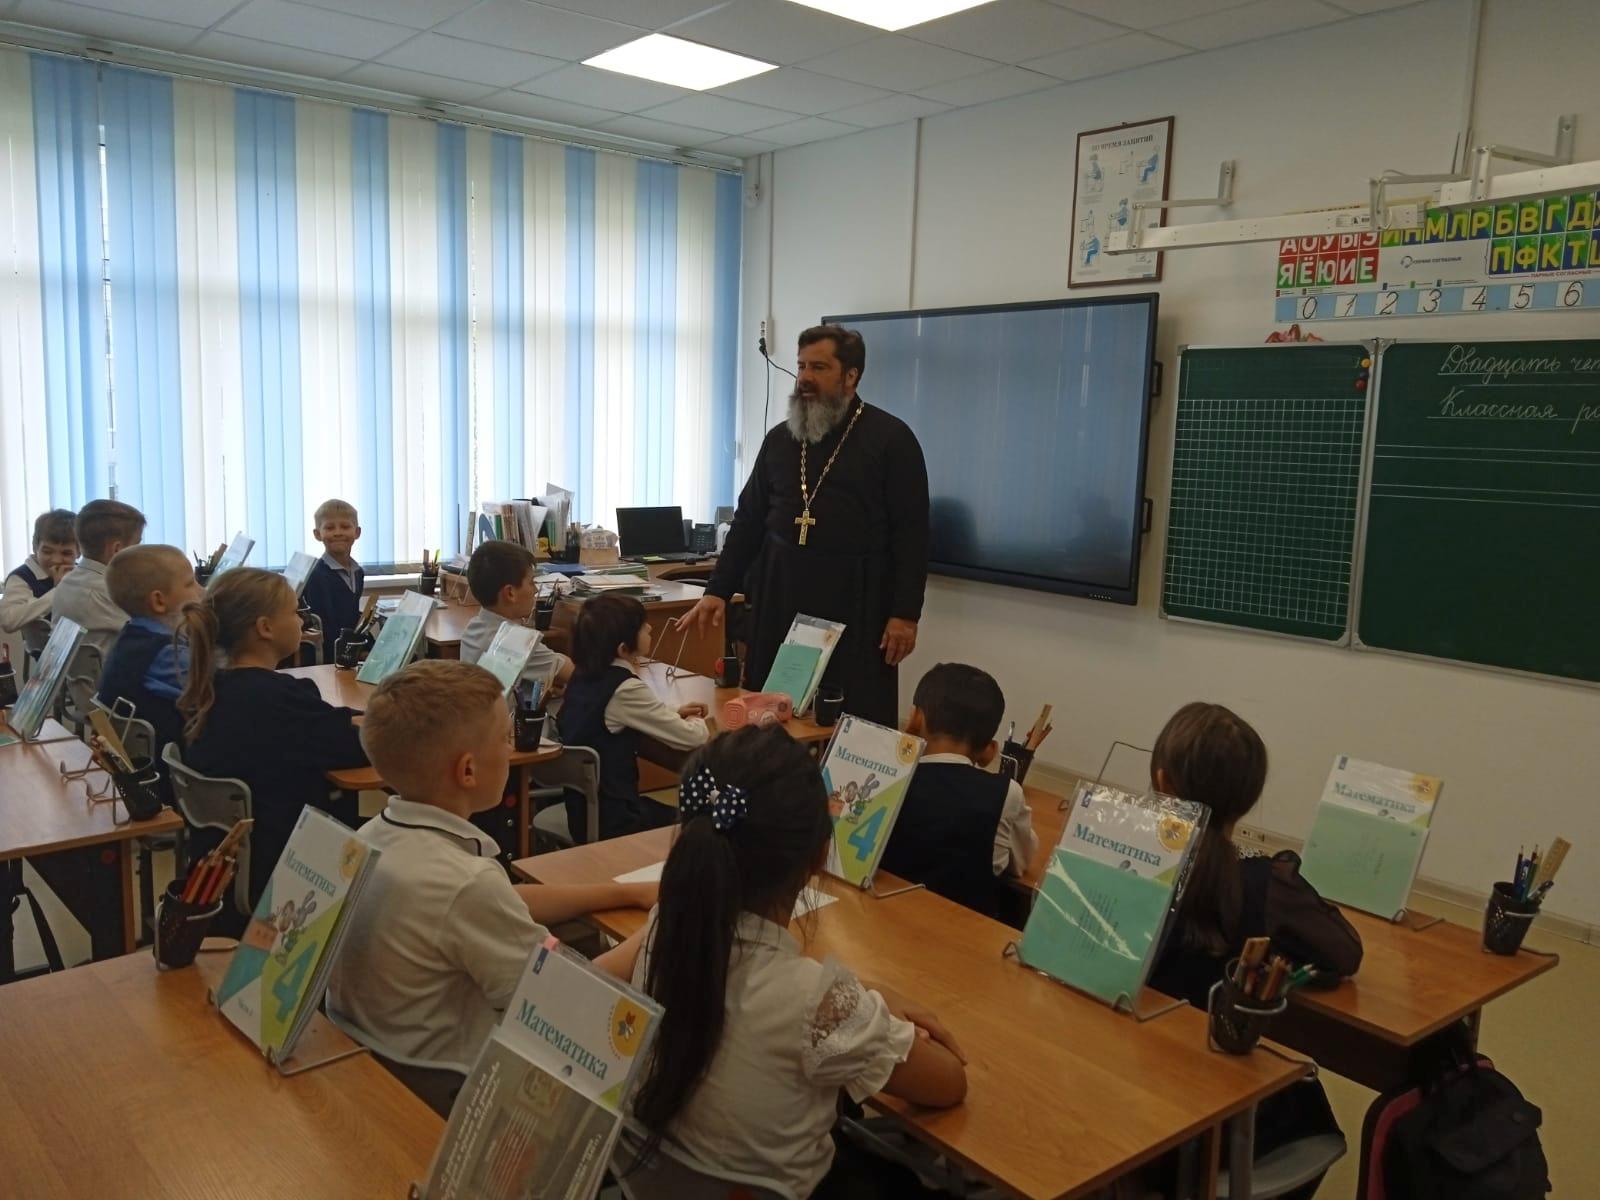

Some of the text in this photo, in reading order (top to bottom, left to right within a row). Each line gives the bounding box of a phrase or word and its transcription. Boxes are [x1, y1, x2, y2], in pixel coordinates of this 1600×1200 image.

[1303, 281, 1584, 319] 0 1 2 3 4 5 6
[1439, 386, 1558, 418] Классная
[835, 745, 898, 778] Математика
[1334, 781, 1416, 814] Математика
[847, 806, 888, 862] 4
[1073, 822, 1161, 867] Математика
[283, 848, 337, 898] Математика
[272, 940, 318, 1024] 4
[516, 998, 608, 1081] Математика
